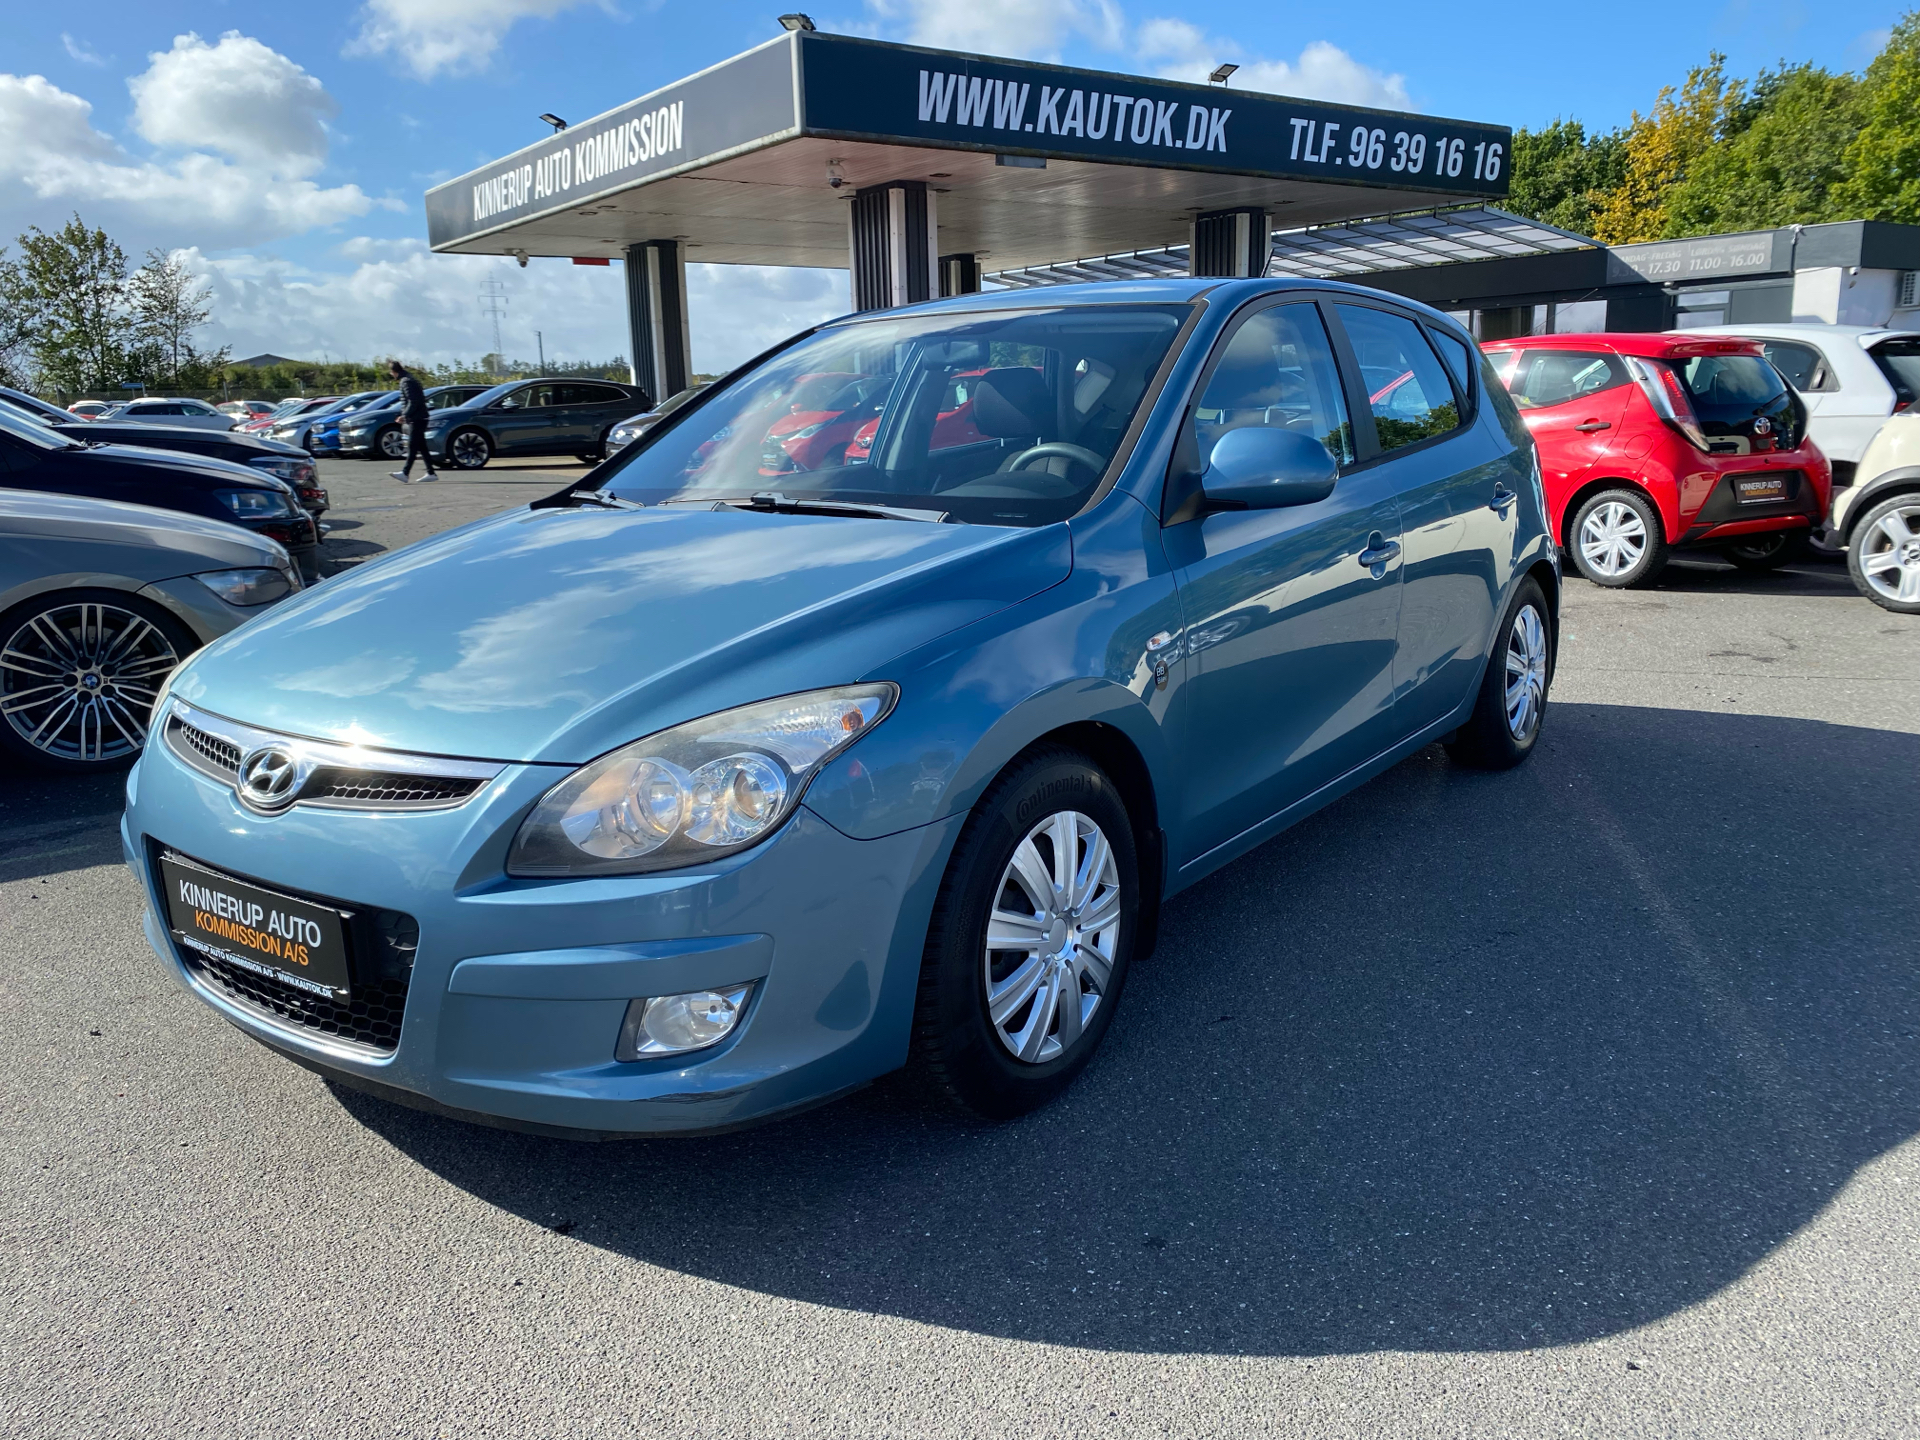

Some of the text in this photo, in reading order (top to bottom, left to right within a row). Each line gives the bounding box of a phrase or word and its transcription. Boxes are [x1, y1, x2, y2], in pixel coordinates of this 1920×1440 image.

[918, 70, 1232, 153] WWW.KAUTOK.DK
[473, 100, 684, 221] KINNERUP AUTO KOMMISSION
[1289, 117, 1503, 181] TLF. 96 39 16 16
[1648, 260, 1681, 274] 17.30
[1689, 256, 1721, 271] 11.00
[1730, 253, 1765, 267] 16.00
[1016, 774, 1085, 824] Continental
[179, 879, 322, 948] KINNERUP AUTO
[195, 909, 309, 967] KOMMISSION A/S
[183, 936, 209, 953] KINNERUP
[210, 948, 226, 959] AUTO
[226, 952, 262, 974] KOMMISSION
[263, 967, 274, 978] A/S
